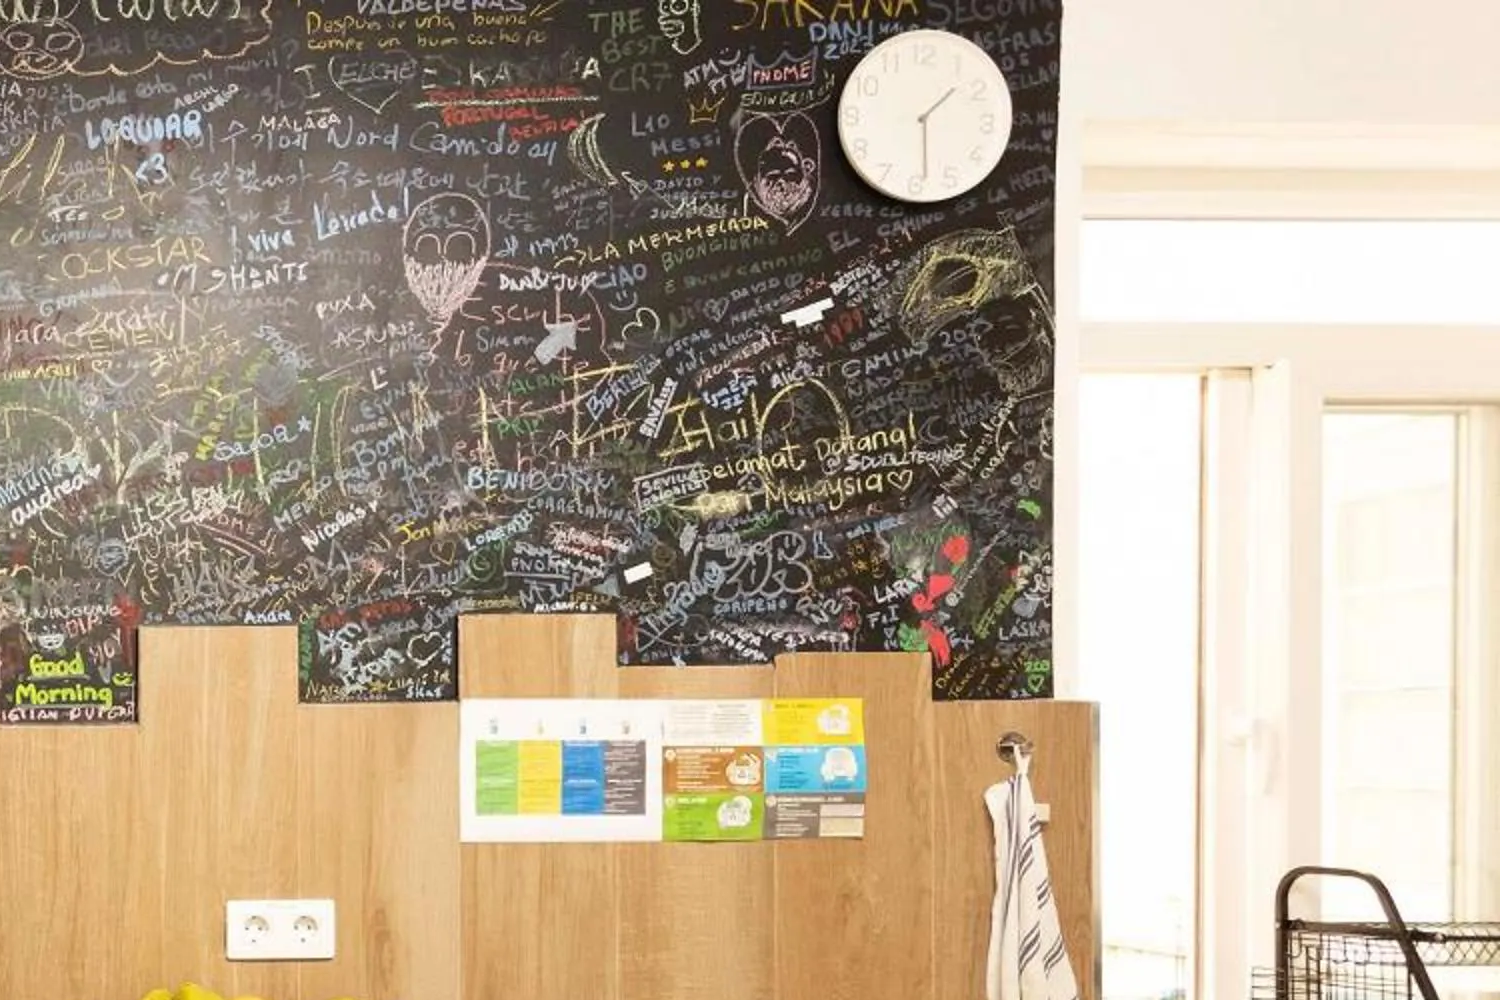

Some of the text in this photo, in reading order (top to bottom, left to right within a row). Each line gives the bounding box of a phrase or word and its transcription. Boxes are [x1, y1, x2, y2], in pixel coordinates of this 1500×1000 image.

[881, 52, 900, 74] 11
[913, 44, 936, 66] 12
[954, 54, 962, 76] 1
[856, 75, 879, 97] 10
[971, 79, 988, 102] 2
[845, 106, 859, 126] 9
[979, 113, 994, 135] 3
[853, 138, 868, 160] 8
[968, 146, 982, 164] 4
[877, 163, 893, 183] 7
[942, 166, 958, 189] 5
[907, 175, 923, 195] 6
[29, 652, 85, 677] Good
[16, 684, 113, 709] Morning
